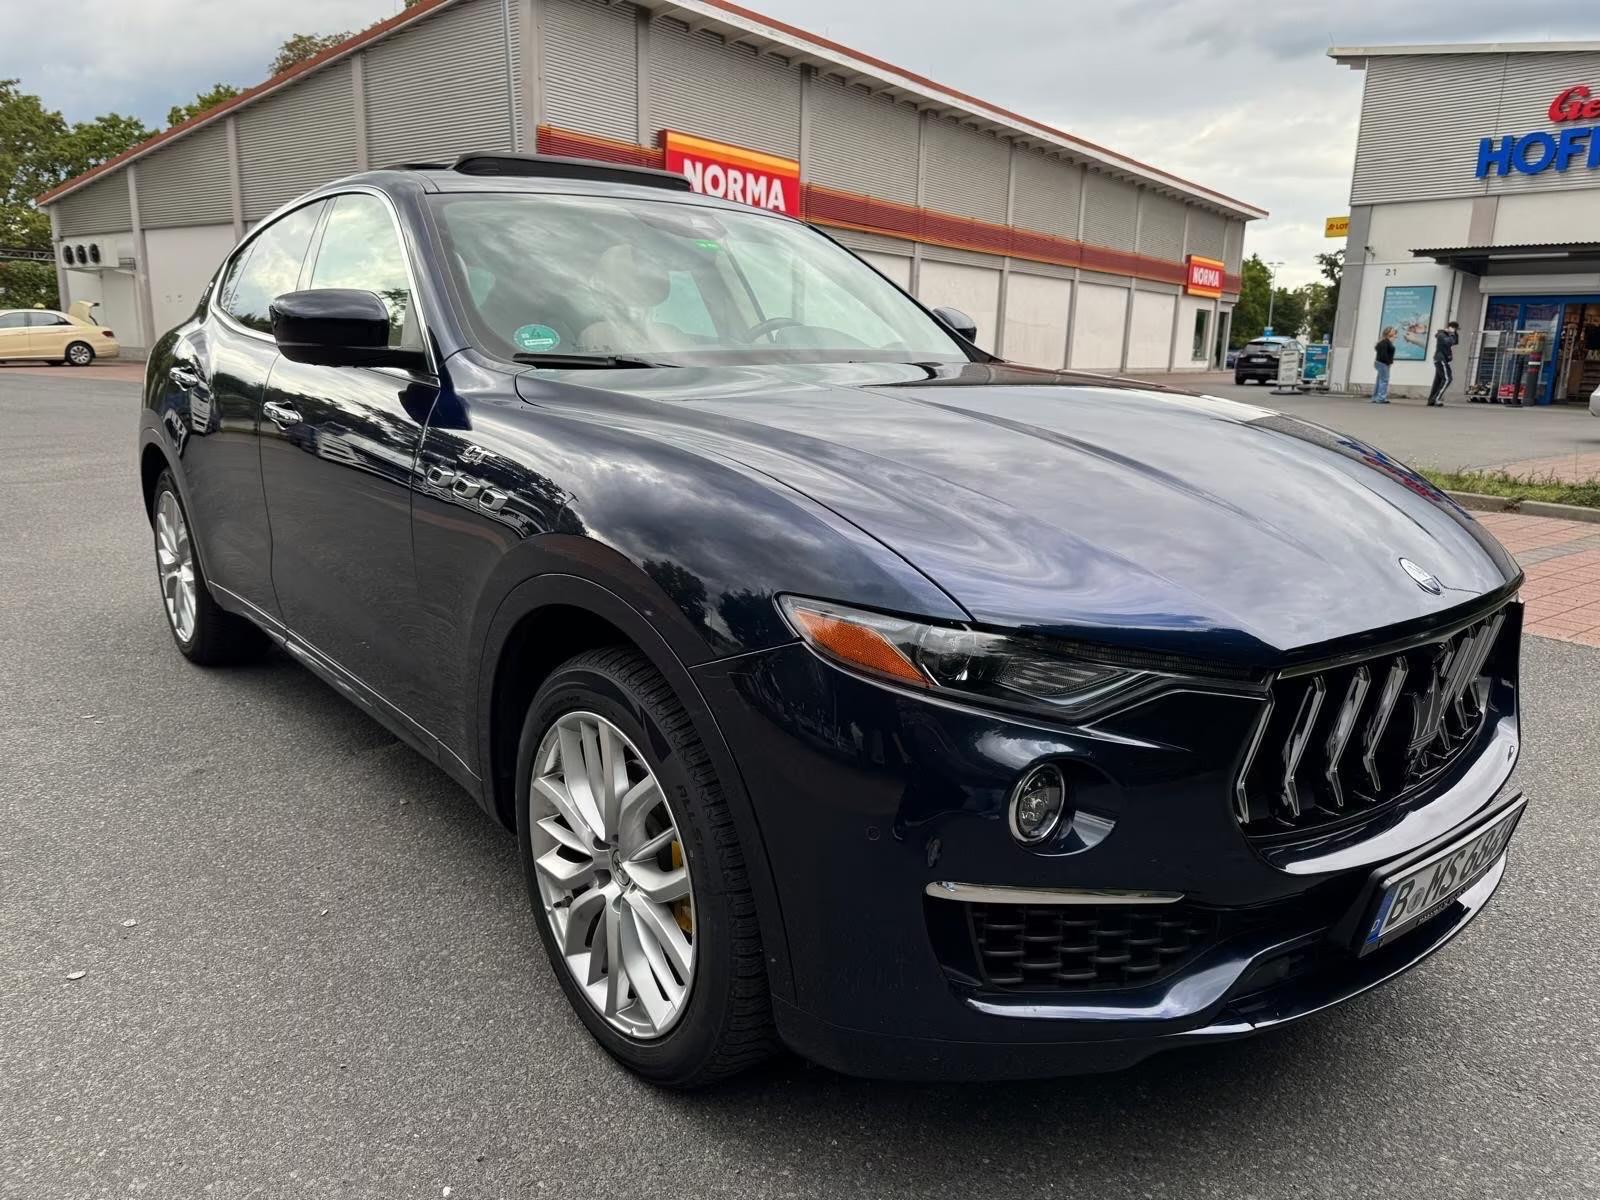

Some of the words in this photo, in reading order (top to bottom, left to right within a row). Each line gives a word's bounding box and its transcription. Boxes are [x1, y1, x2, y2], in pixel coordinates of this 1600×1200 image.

[683, 158, 786, 212] NORMA
[1192, 266, 1220, 287] NORMA
[1385, 268, 1397, 276] 21
[461, 445, 499, 465] GT
[1384, 879, 1415, 927] B
[1421, 849, 1466, 907] MS
